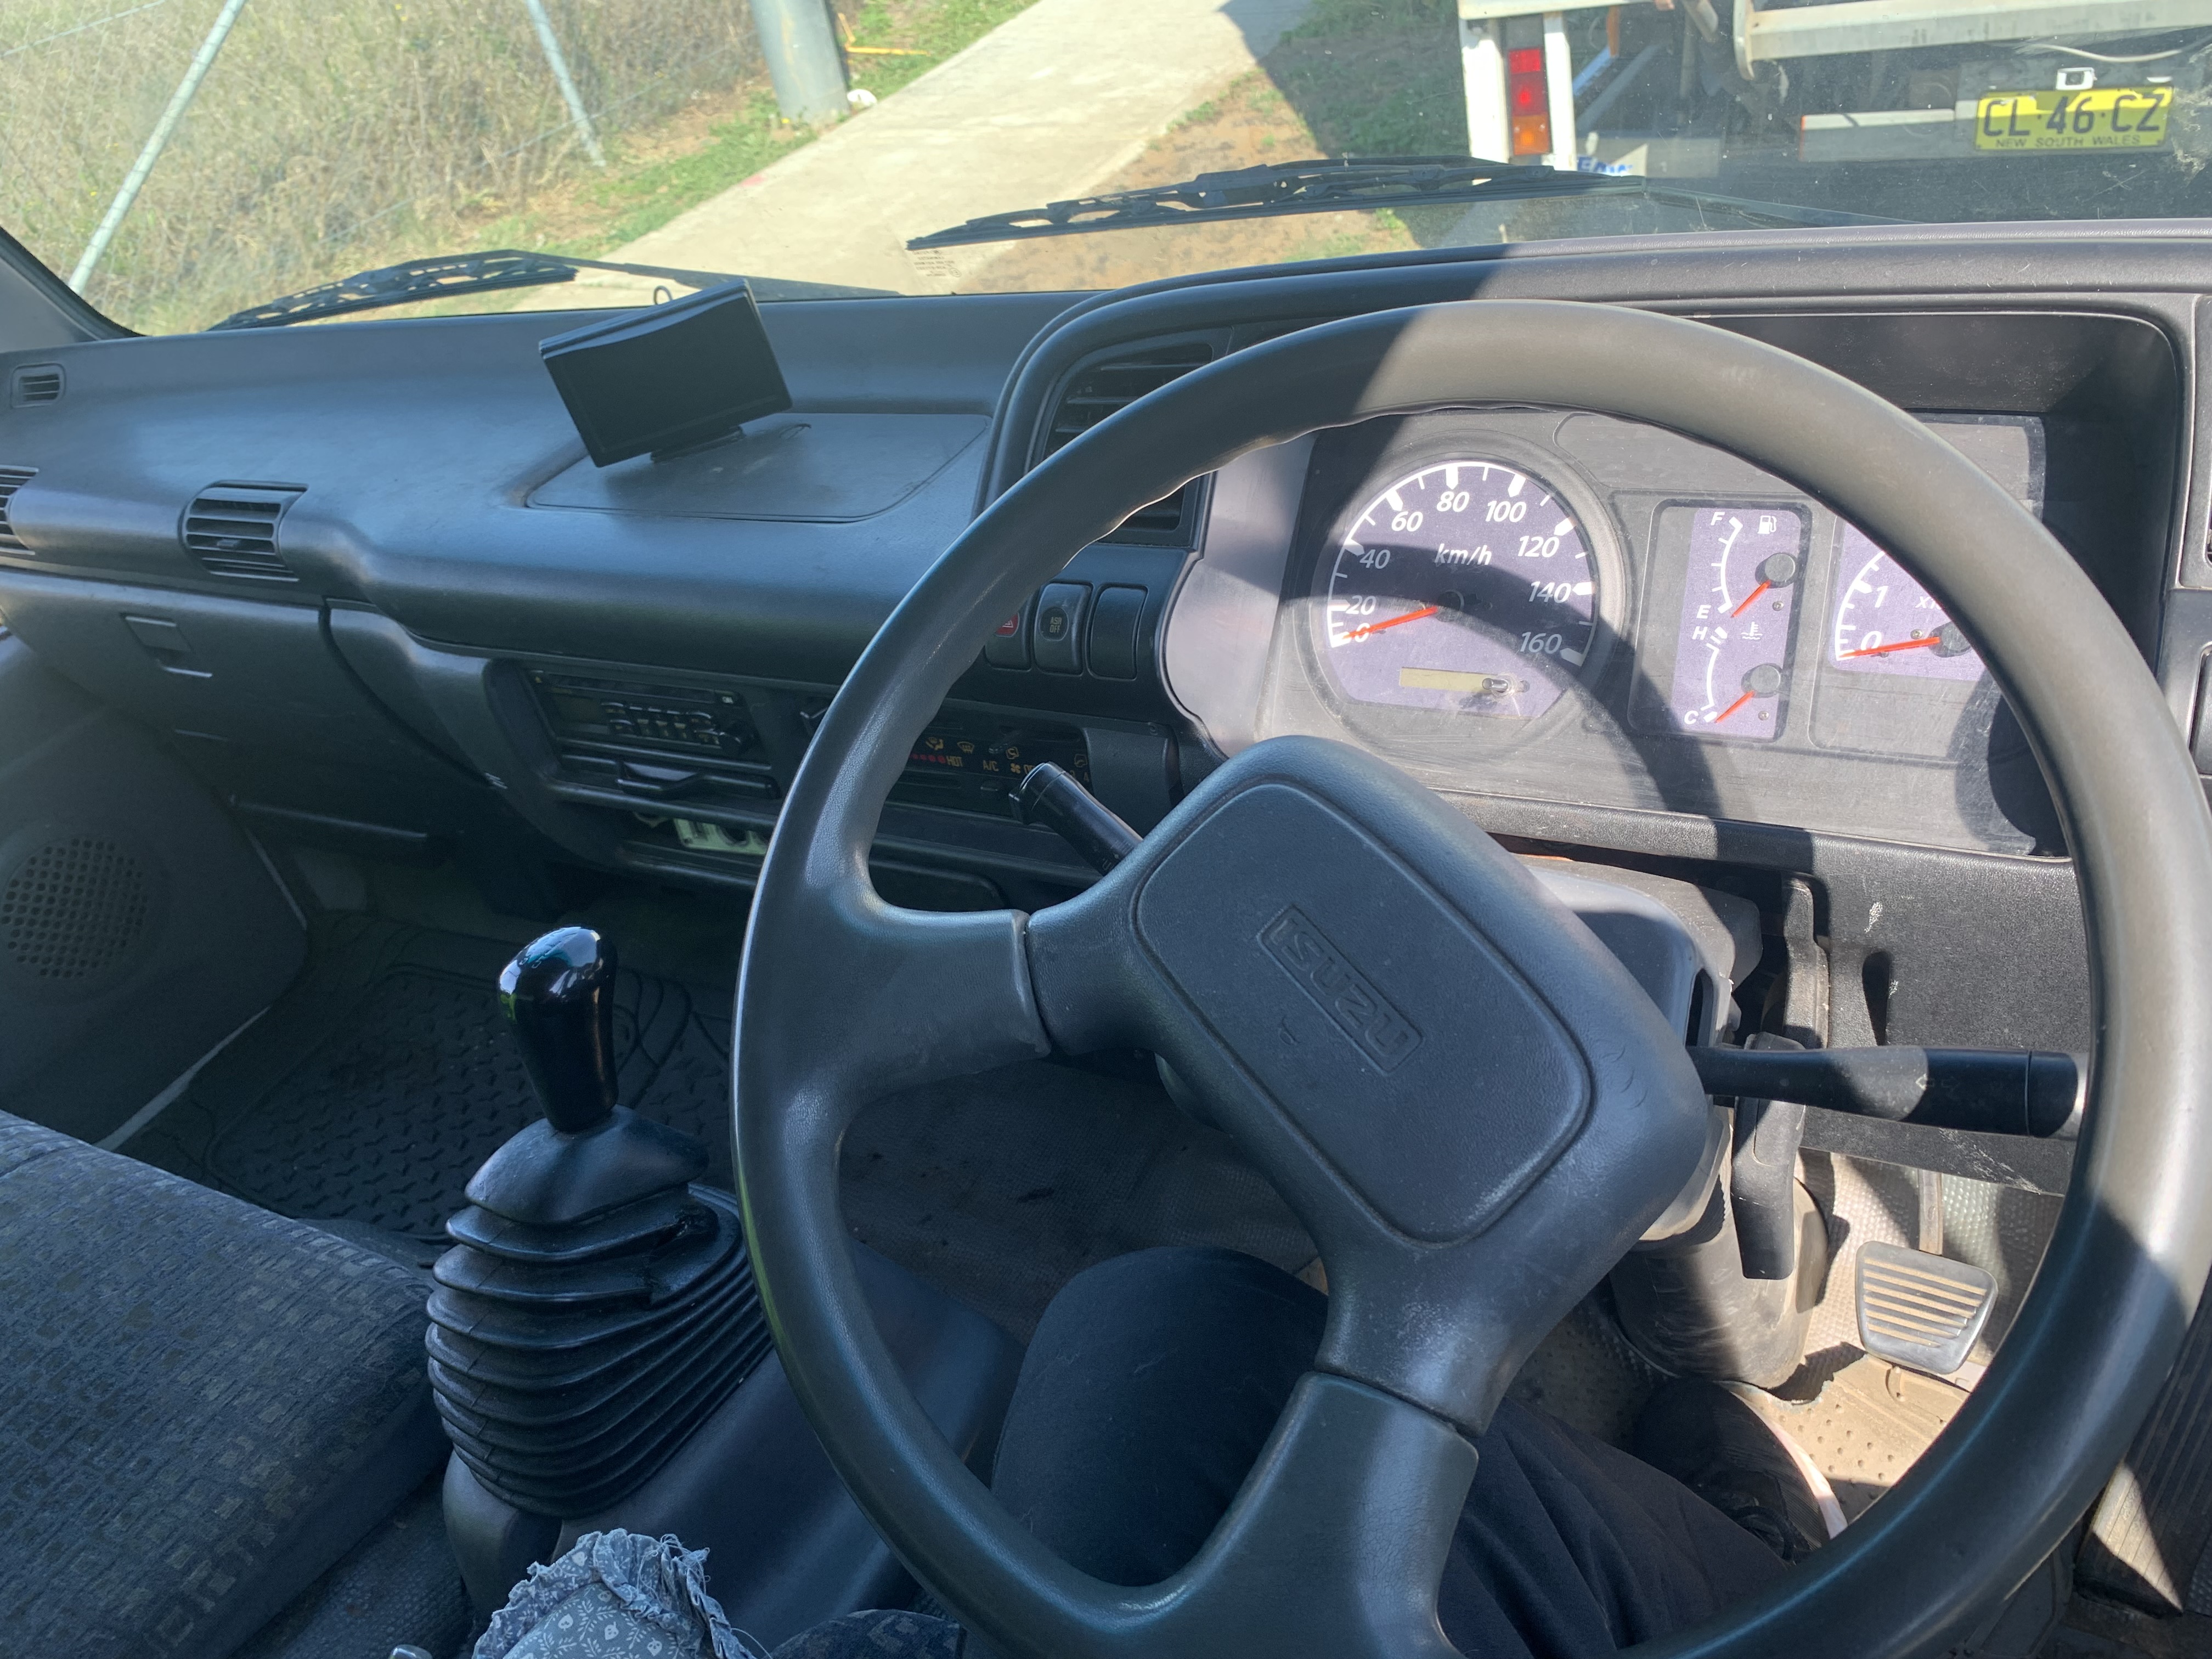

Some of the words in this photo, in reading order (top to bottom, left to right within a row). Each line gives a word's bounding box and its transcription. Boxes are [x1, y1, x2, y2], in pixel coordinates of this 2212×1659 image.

[1995, 138, 2027, 148] NEW
[2035, 136, 2084, 148] SOUTH
[2092, 134, 2141, 146] WALES
[1436, 492, 1470, 512] 80
[1485, 501, 1526, 522] 100
[1391, 511, 1423, 532] 60
[1711, 512, 1725, 526] F
[1435, 543, 1492, 566] km/h
[1517, 536, 1559, 557] 120
[1359, 549, 1390, 568] 40
[1529, 582, 1571, 603] 140
[1874, 585, 1889, 608] 1
[1346, 595, 1376, 615] 20
[1696, 605, 1711, 619] E
[1049, 624, 1061, 633] OFF
[1355, 623, 1370, 642] 0
[1692, 627, 1708, 641] H
[1520, 631, 1562, 654] 160
[1860, 630, 1882, 652] 0
[1684, 710, 1699, 724] C
[946, 755, 963, 768] HOT
[983, 759, 1000, 772] A/C
[1269, 917, 1409, 1058] ISUZU
